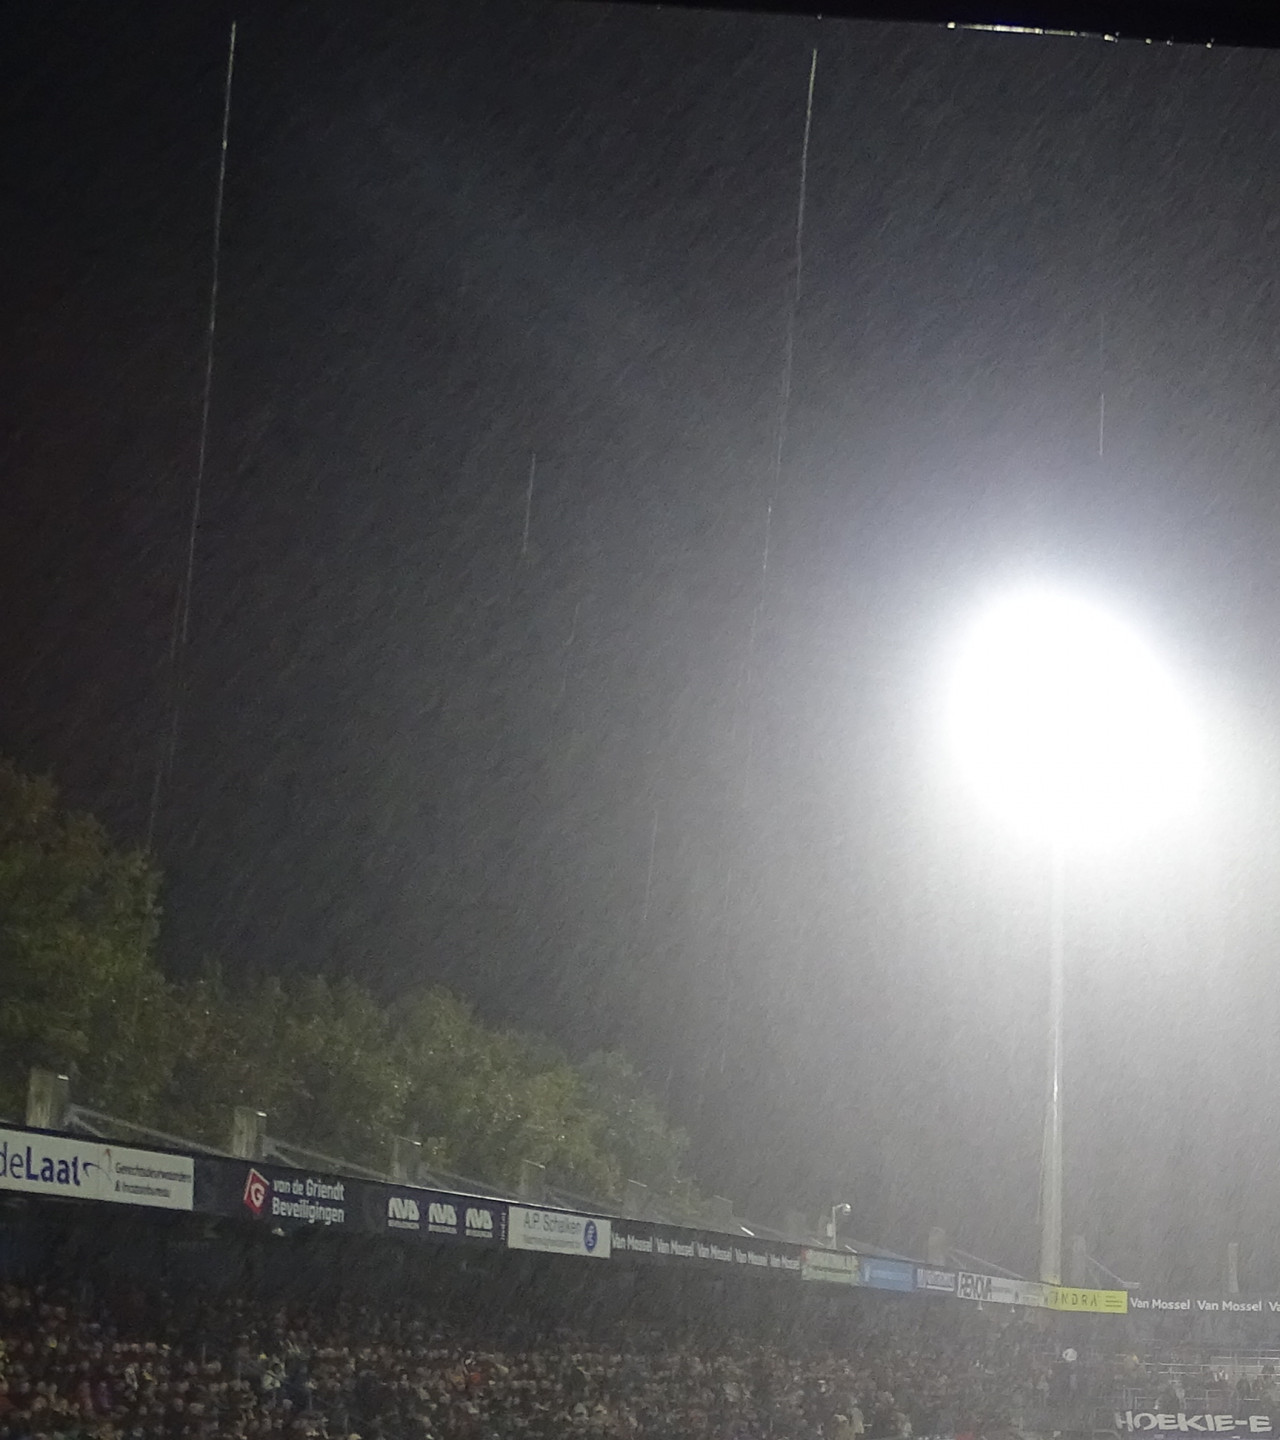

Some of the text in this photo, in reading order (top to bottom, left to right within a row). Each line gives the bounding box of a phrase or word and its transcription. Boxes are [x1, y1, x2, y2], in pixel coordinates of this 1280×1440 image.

[292, 1180, 304, 1195] de
[306, 1179, 344, 1200] Griendt
[272, 1198, 344, 1225] Beveiligingen
[1130, 1297, 1149, 1309] Van
[1152, 1299, 1190, 1310] Mossel
[1197, 1300, 1262, 1312] Van Mossel
